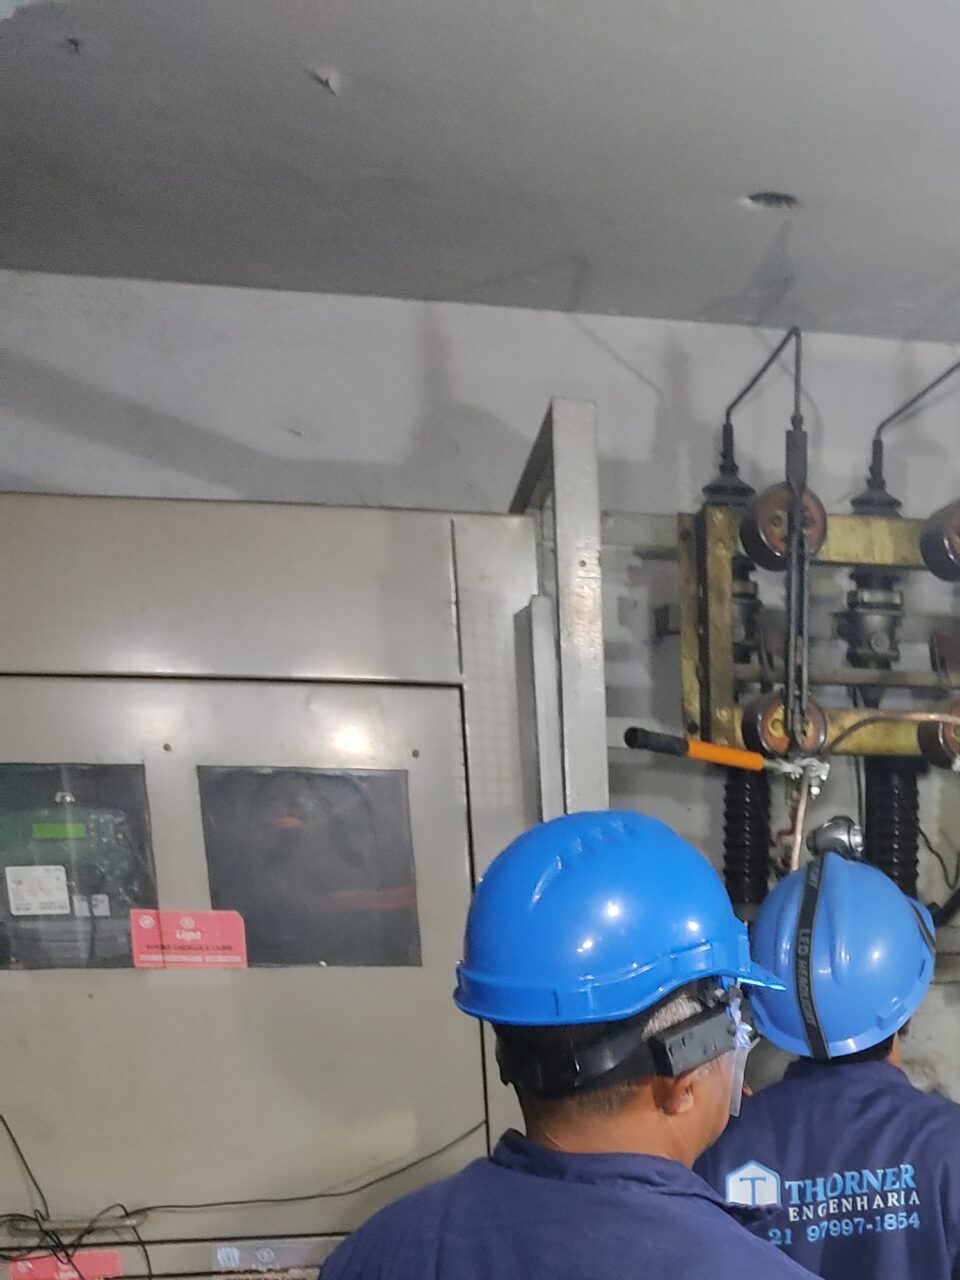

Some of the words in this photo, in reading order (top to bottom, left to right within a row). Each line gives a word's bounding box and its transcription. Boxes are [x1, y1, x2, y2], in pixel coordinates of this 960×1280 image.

[784, 1164, 917, 1204] THORNER
[788, 1190, 920, 1222] ENGENHARIA
[806, 1212, 920, 1242] 97997-1854
